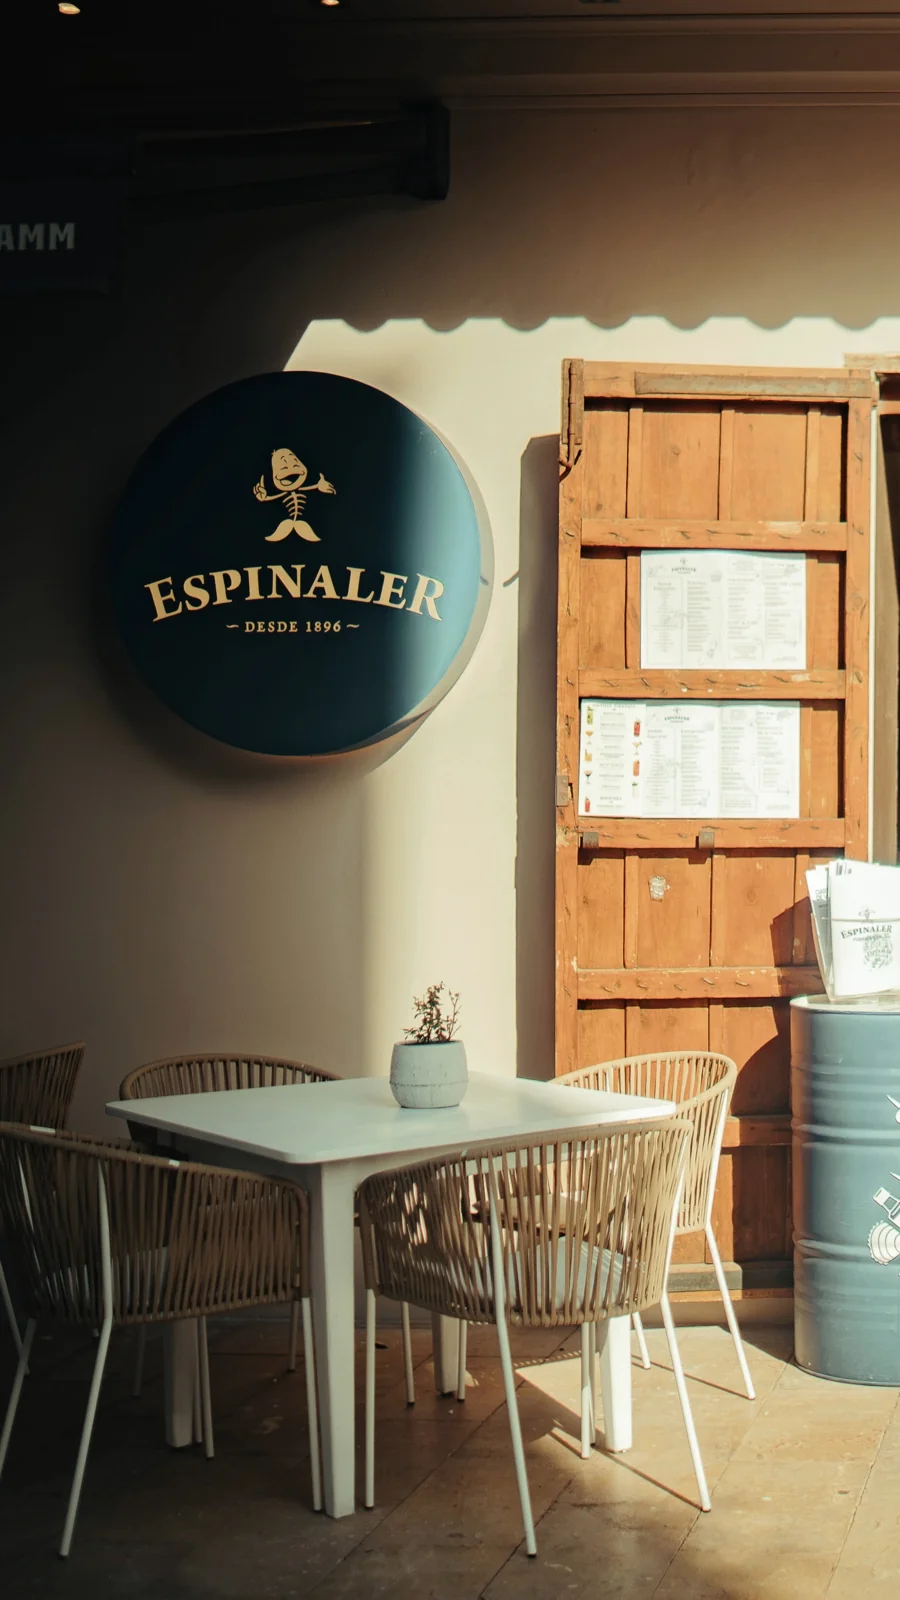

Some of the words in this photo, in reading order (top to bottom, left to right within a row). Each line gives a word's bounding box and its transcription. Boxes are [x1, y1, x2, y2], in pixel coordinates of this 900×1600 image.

[144, 564, 445, 622] ESPINALER
[244, 620, 298, 633] DESDE
[305, 620, 342, 633] 1896
[840, 924, 892, 940] ESPINALER
